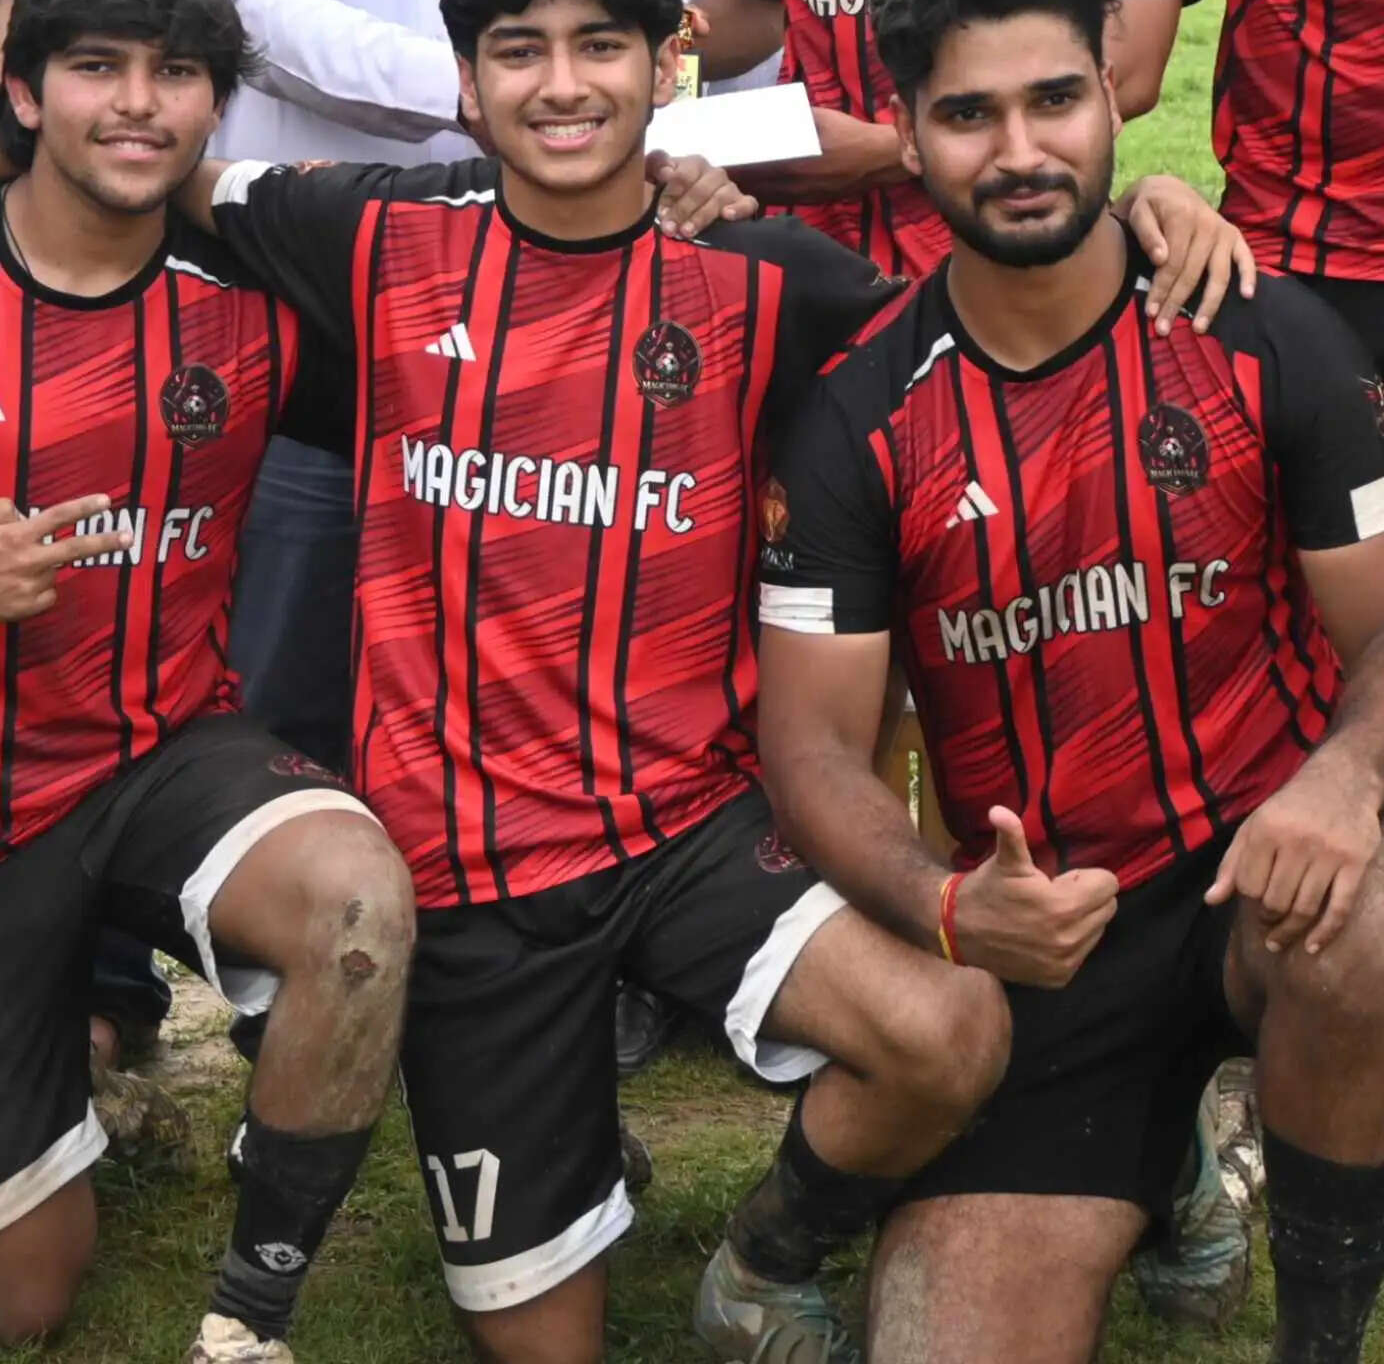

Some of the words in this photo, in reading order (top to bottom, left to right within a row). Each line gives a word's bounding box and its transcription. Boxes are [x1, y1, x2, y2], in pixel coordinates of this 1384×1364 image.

[401, 433, 617, 527] MAGICIAN
[634, 470, 696, 533] FC
[157, 505, 214, 562] FC
[1169, 559, 1230, 619] FC
[427, 1147, 501, 1243] 17
